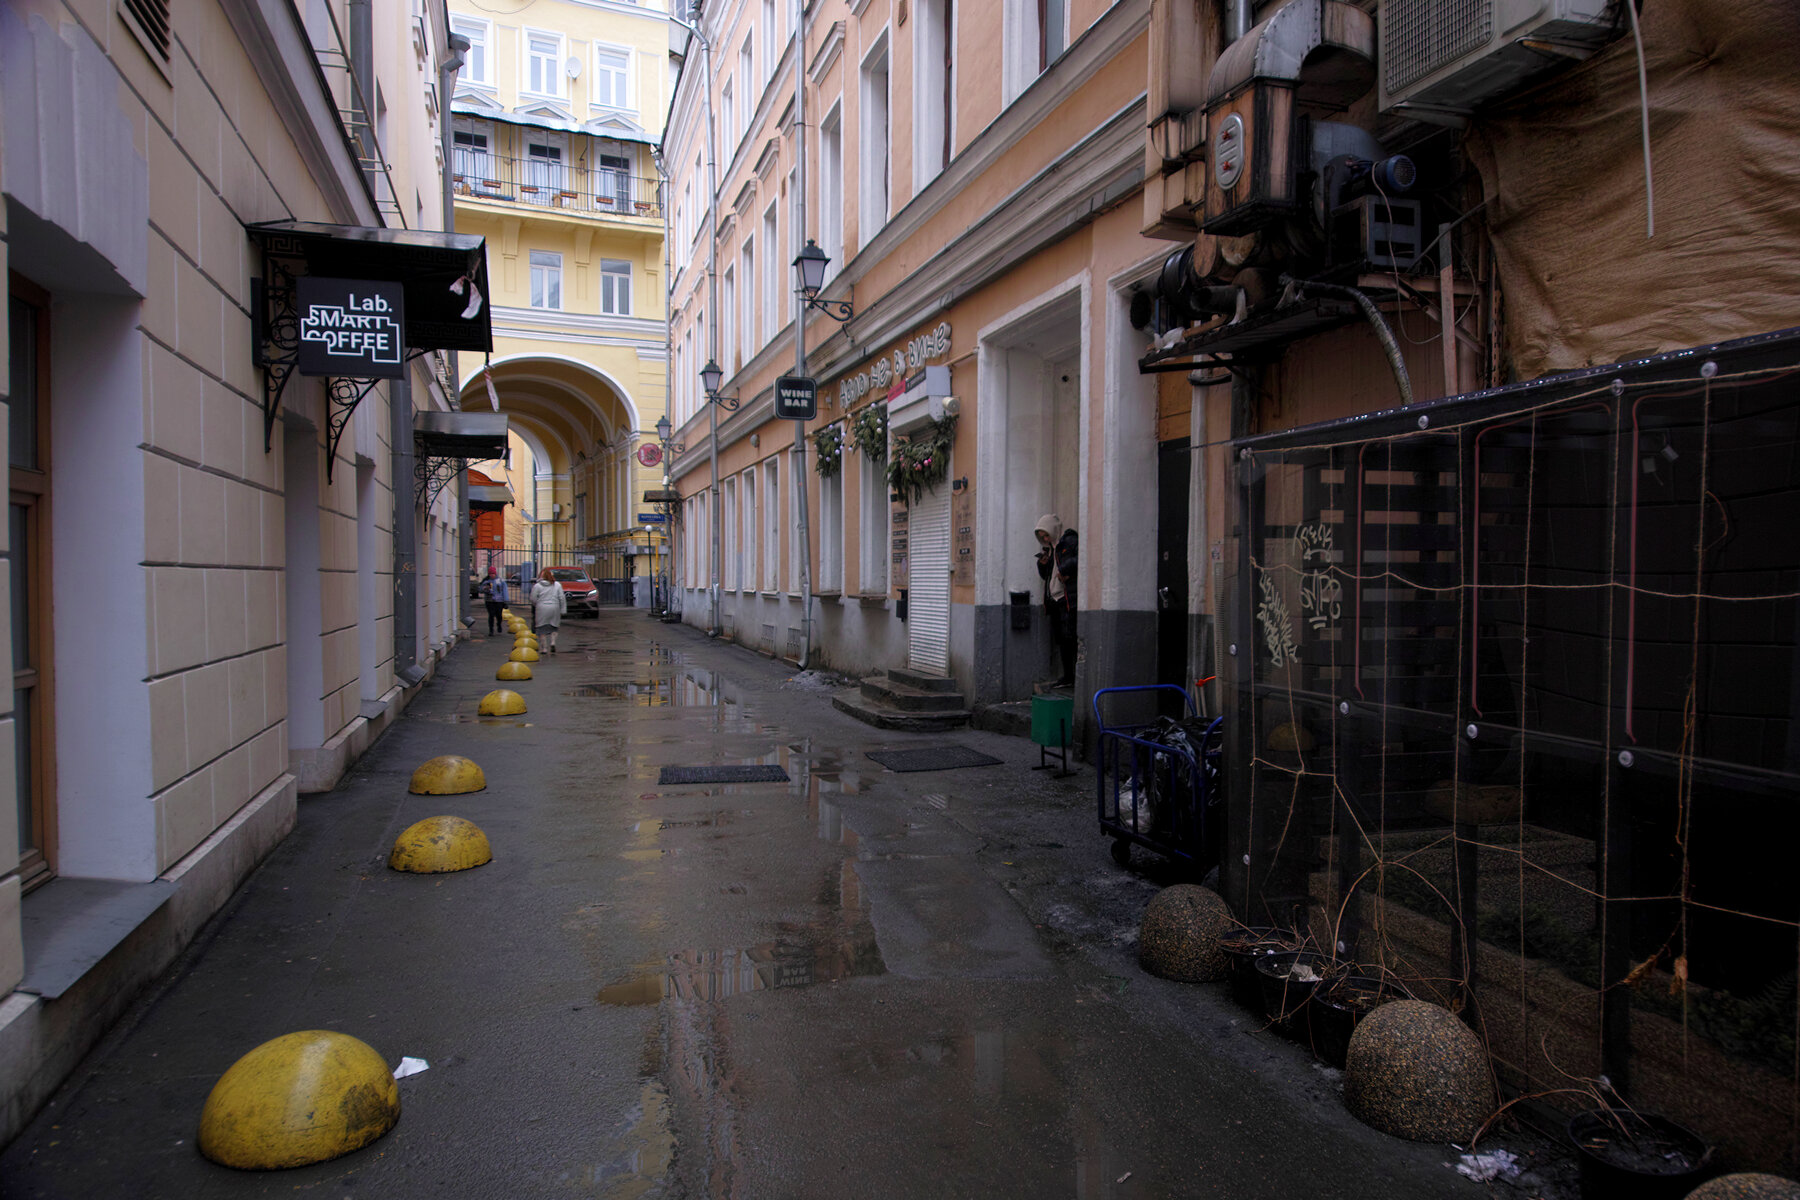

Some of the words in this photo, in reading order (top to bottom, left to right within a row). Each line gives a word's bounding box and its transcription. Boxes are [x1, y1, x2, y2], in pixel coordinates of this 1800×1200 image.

[349, 293, 394, 313] Lab.
[306, 309, 385, 330] SMART
[780, 389, 812, 399] WINE
[784, 398, 808, 408] BAR
